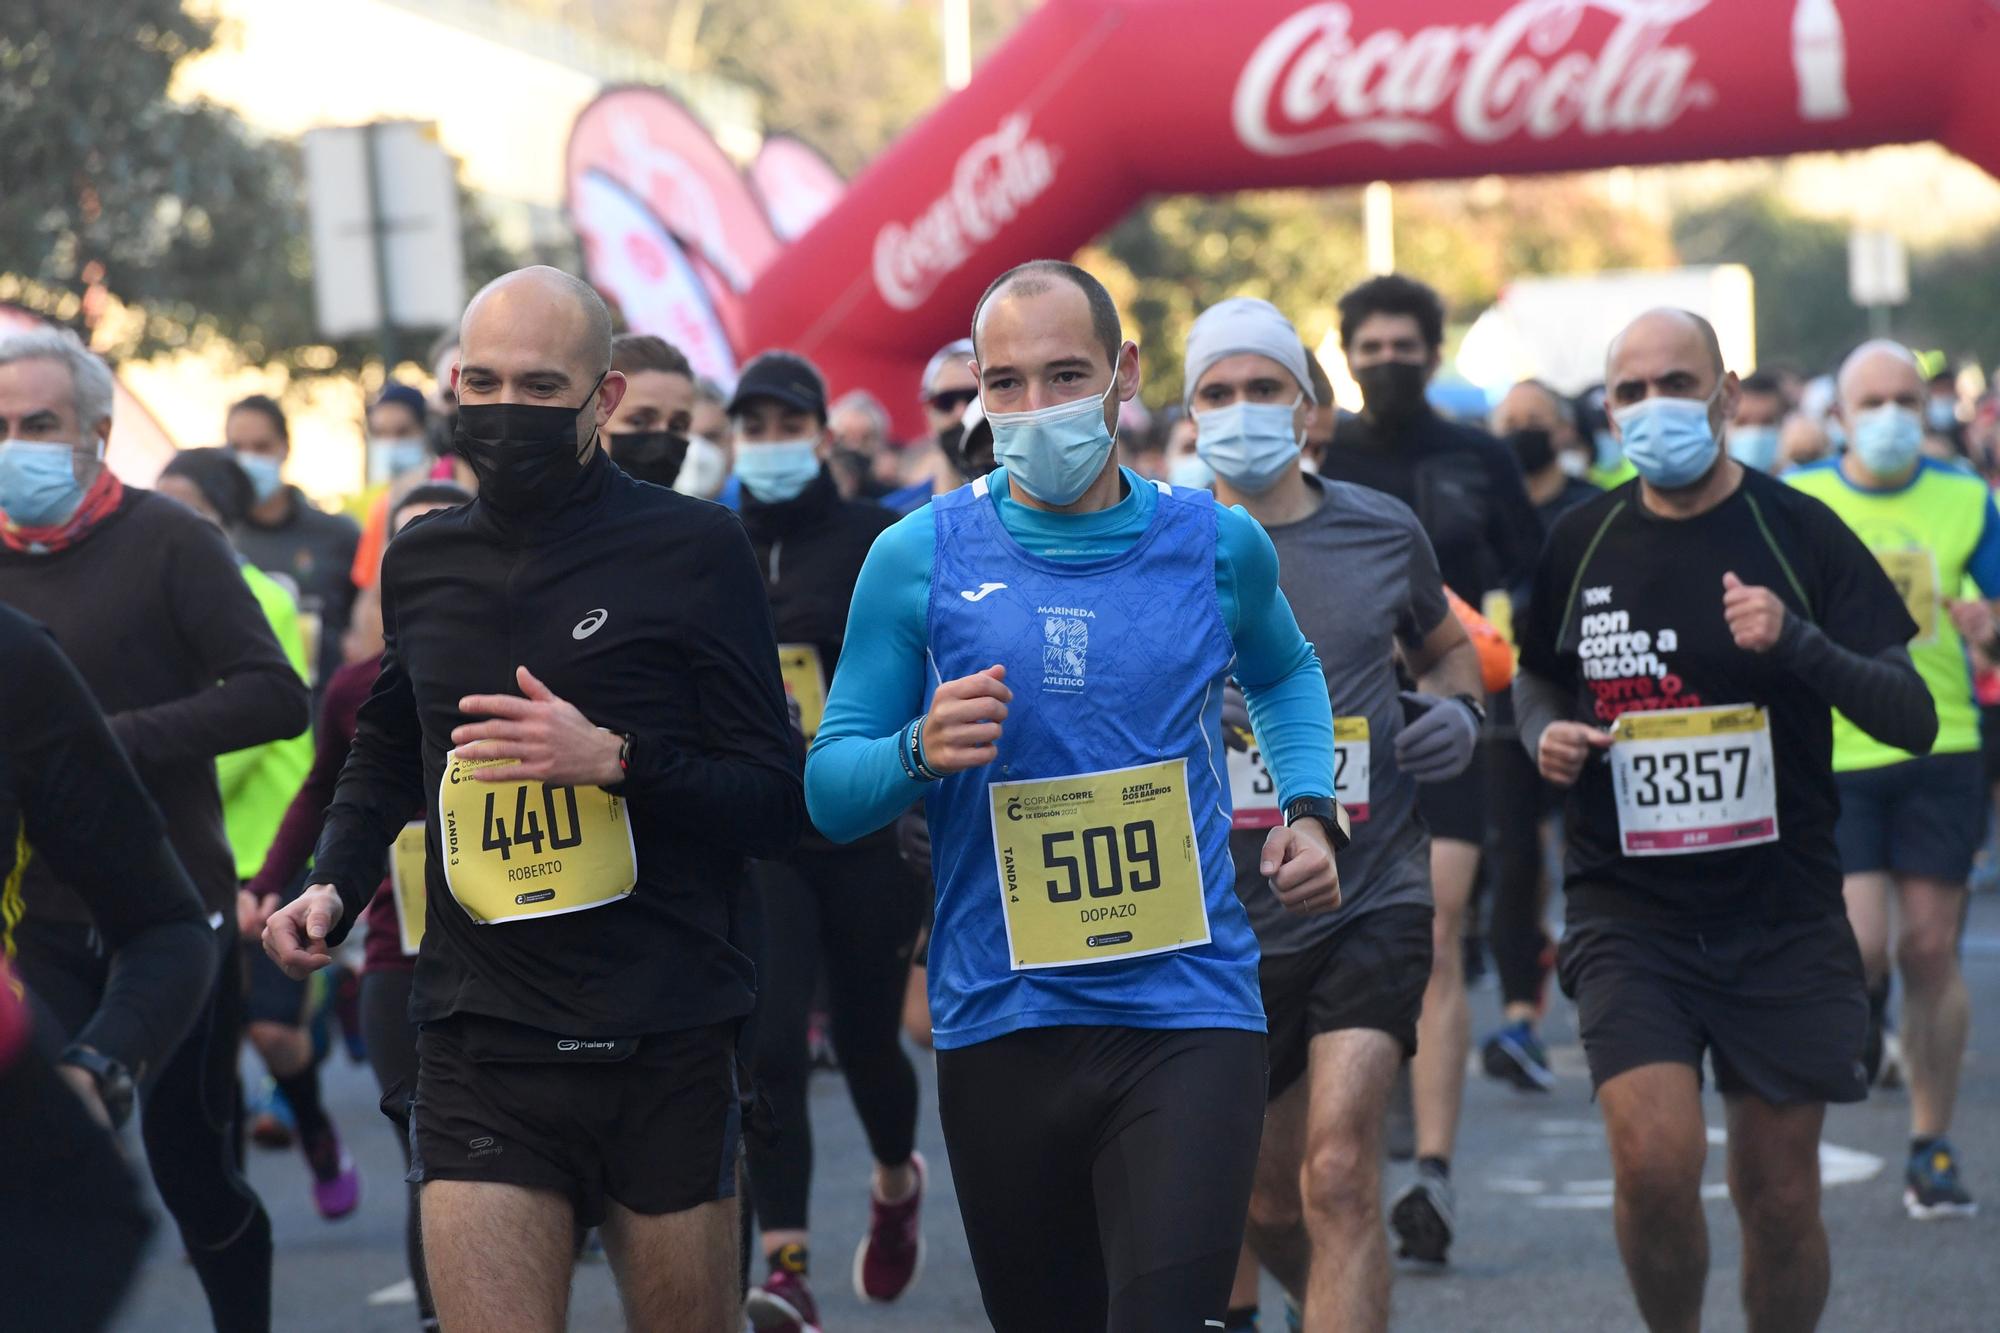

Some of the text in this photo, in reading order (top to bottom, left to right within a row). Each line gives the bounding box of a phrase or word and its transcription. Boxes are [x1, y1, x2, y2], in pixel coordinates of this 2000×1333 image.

[1038, 606, 1096, 618] MARINEDA
[1581, 609, 1629, 637] non
[1578, 628, 1678, 659] corre a
[1042, 676, 1085, 687] ATLETICO
[1252, 747, 1348, 794] 32
[1633, 747, 1751, 807] 3357
[1122, 792, 1139, 801] DOS
[1140, 785, 1172, 798] BARRIOS
[1129, 782, 1153, 793] XENTE
[482, 783, 582, 860] 440
[1033, 809, 1061, 818] EDICIÓN
[446, 810, 459, 855] TANDA
[508, 860, 562, 882] ROBERTO
[1041, 819, 1161, 903] 509
[1003, 847, 1020, 903] TANDA 4
[1080, 903, 1137, 923] DOPAZO
[580, 1040, 615, 1050] Kalenji
